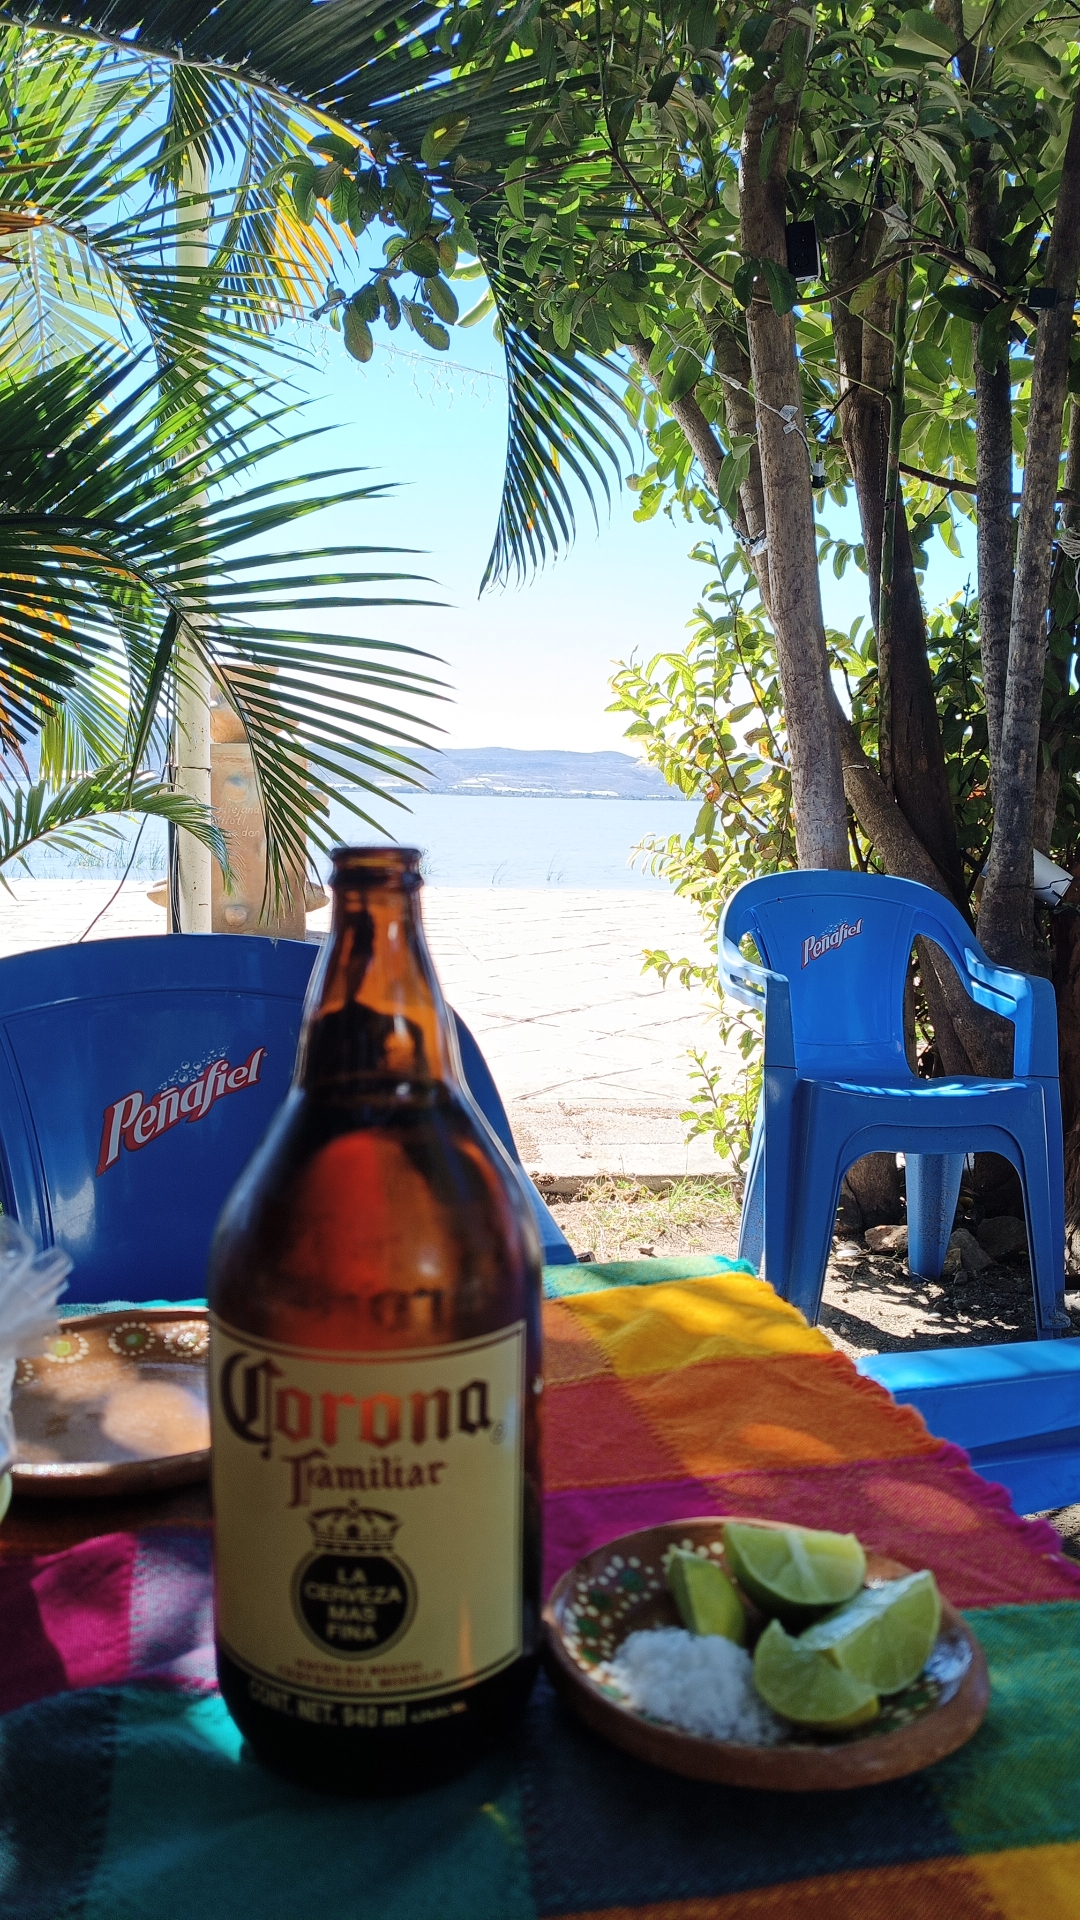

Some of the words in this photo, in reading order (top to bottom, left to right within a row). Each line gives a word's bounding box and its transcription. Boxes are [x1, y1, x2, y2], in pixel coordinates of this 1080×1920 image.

[801, 918, 863, 970] Peñafiel
[97, 1046, 265, 1176] Peñafiel
[220, 1350, 493, 1460] Corona
[283, 1447, 447, 1510] Familiar
[303, 1581, 402, 1605] CERVEZA
[336, 1565, 368, 1585] LA
[325, 1622, 379, 1642] FINA
